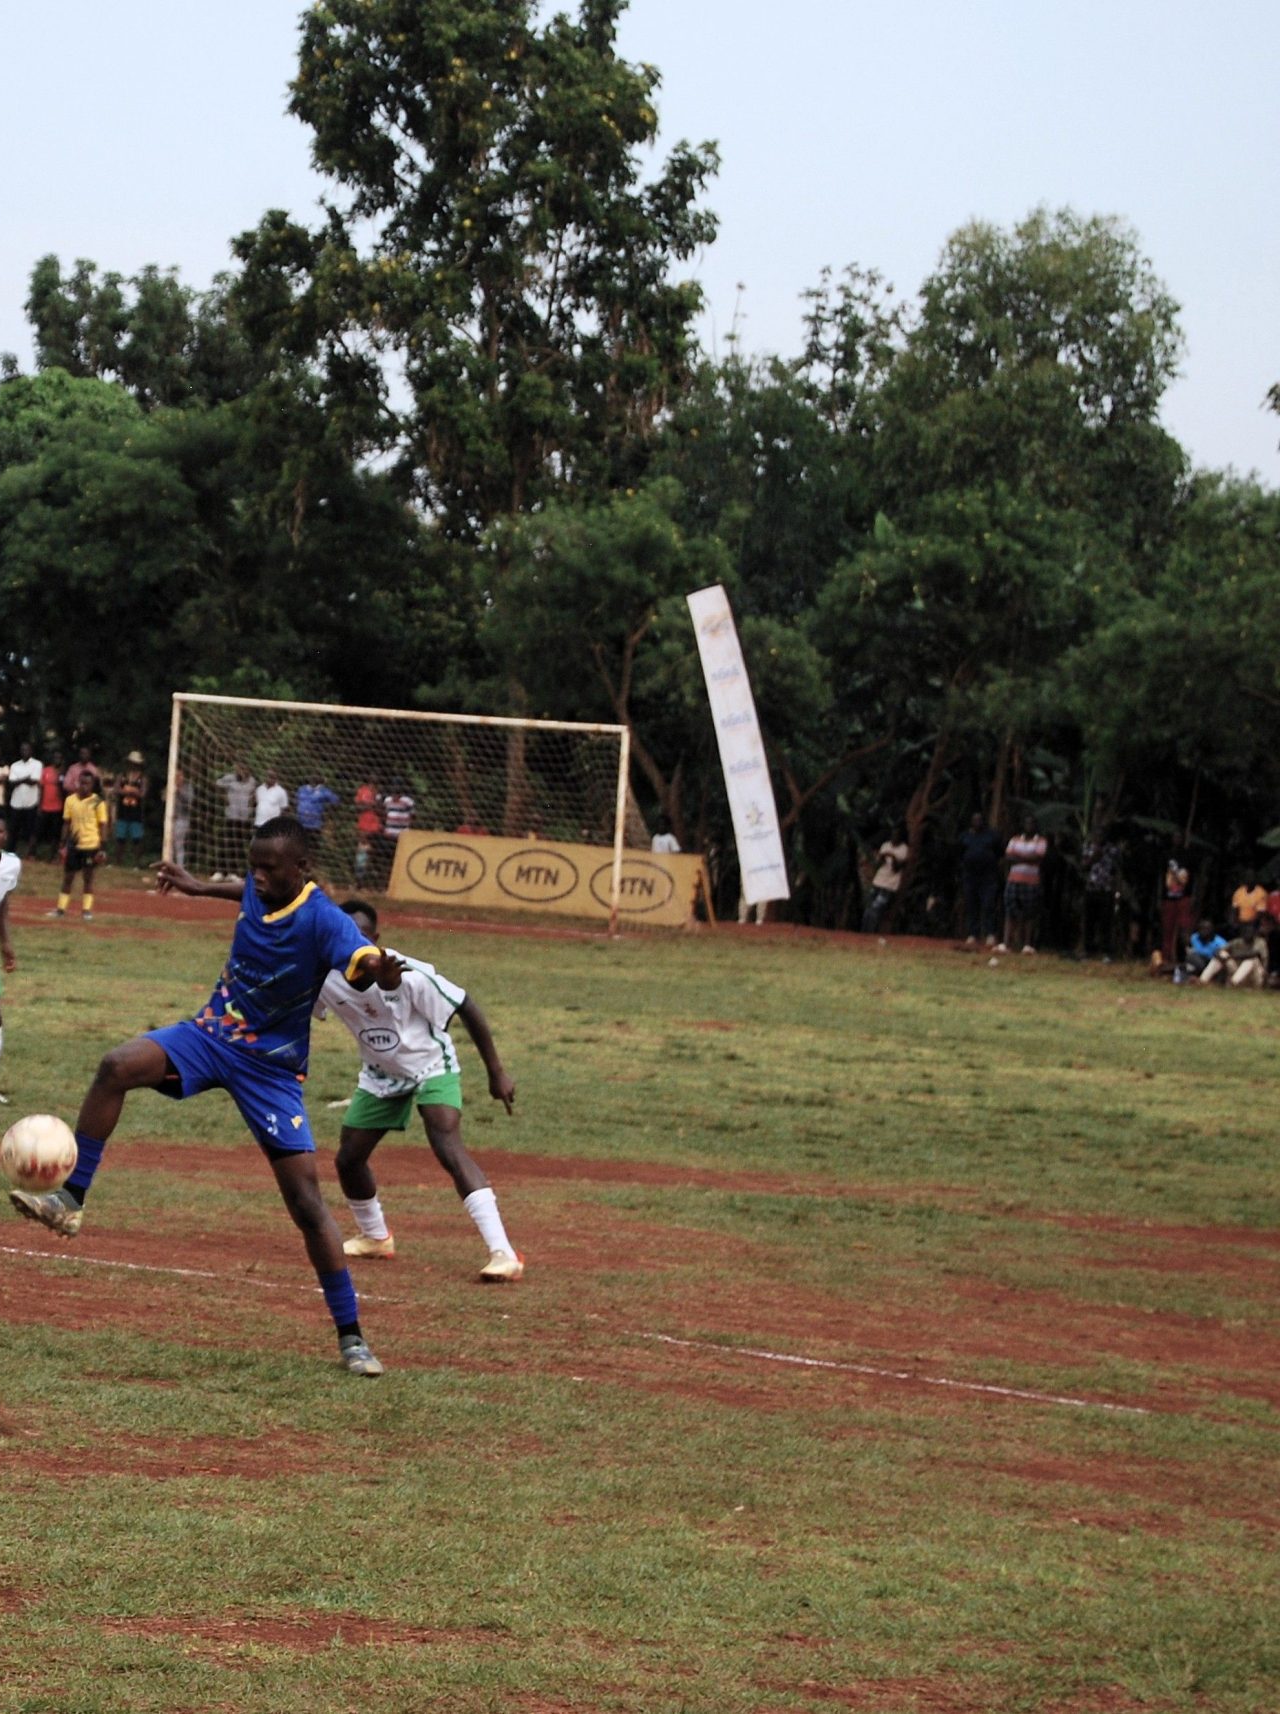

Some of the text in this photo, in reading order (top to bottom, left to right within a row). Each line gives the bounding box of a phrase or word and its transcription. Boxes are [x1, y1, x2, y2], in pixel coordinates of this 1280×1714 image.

[424, 857, 468, 879] MTN
[515, 865, 560, 886] MTN
[367, 1034, 391, 1045] MTN
